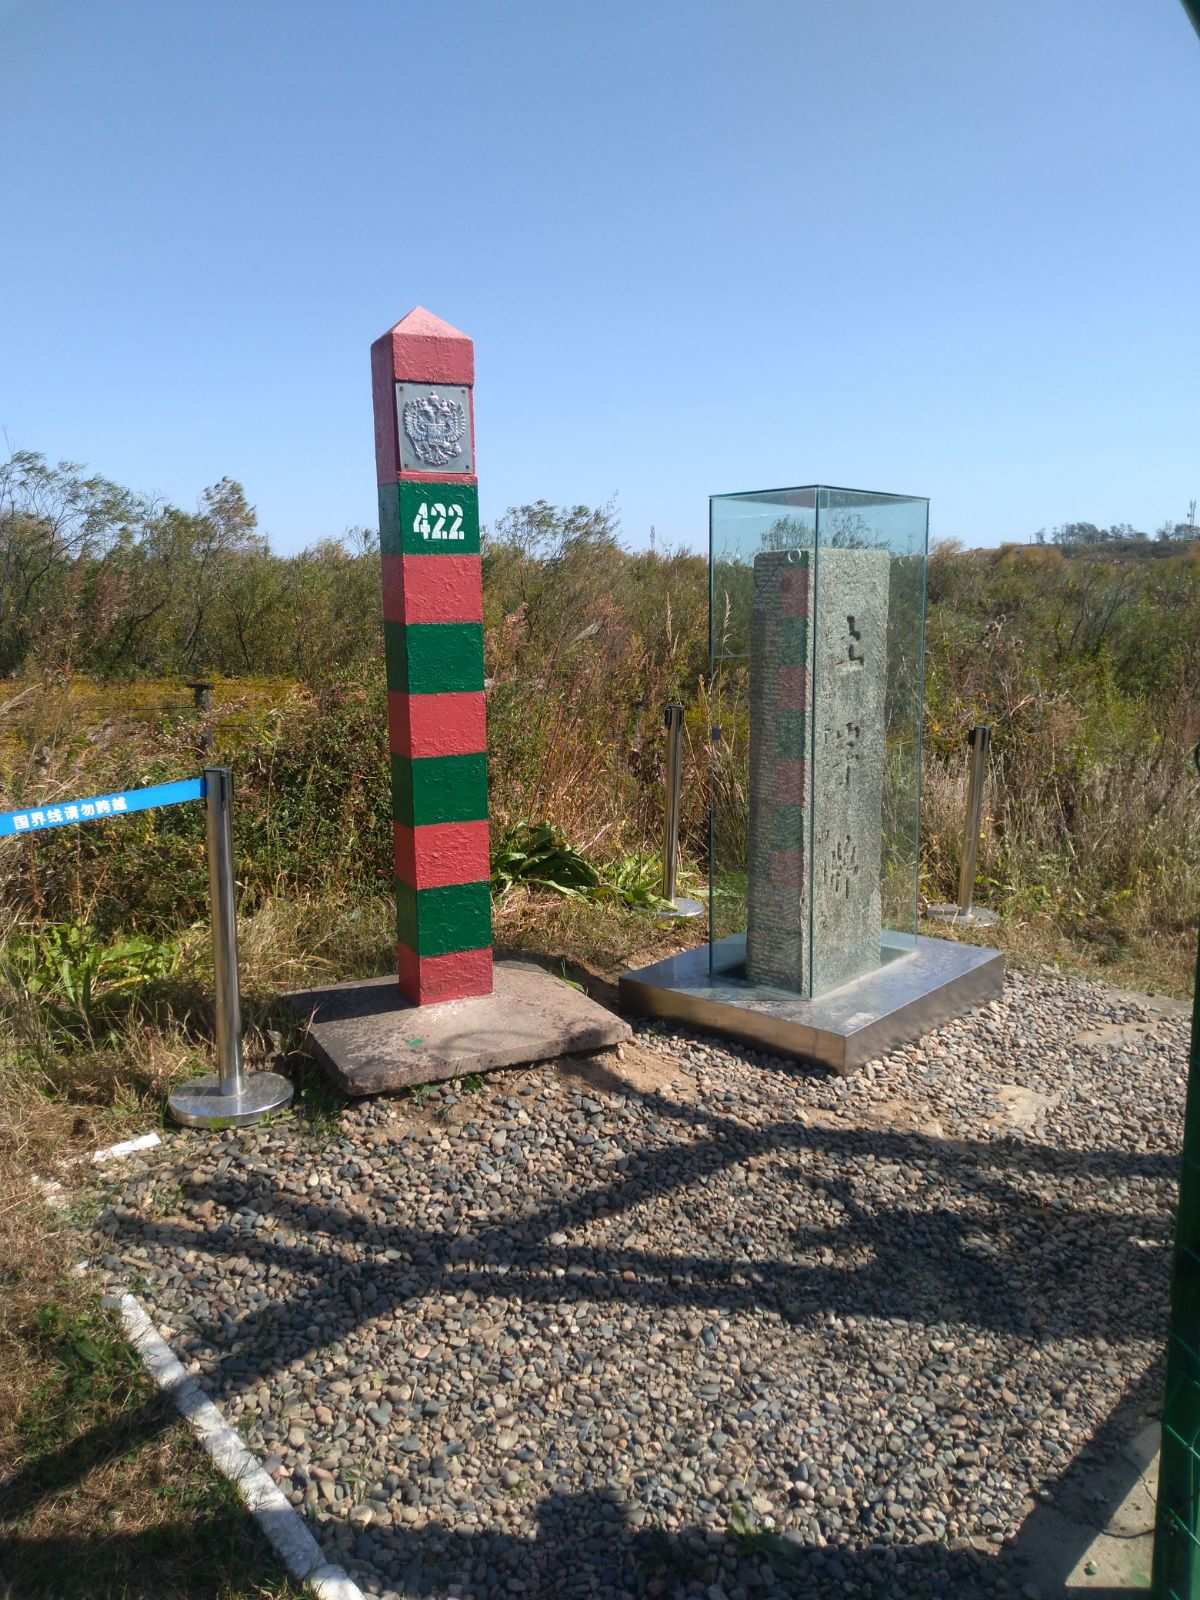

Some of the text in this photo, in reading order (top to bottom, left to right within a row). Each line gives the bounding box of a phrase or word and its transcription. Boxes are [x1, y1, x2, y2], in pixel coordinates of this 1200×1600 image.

[413, 502, 465, 540] 422
[14, 797, 128, 829] 国界线请勿跨越
